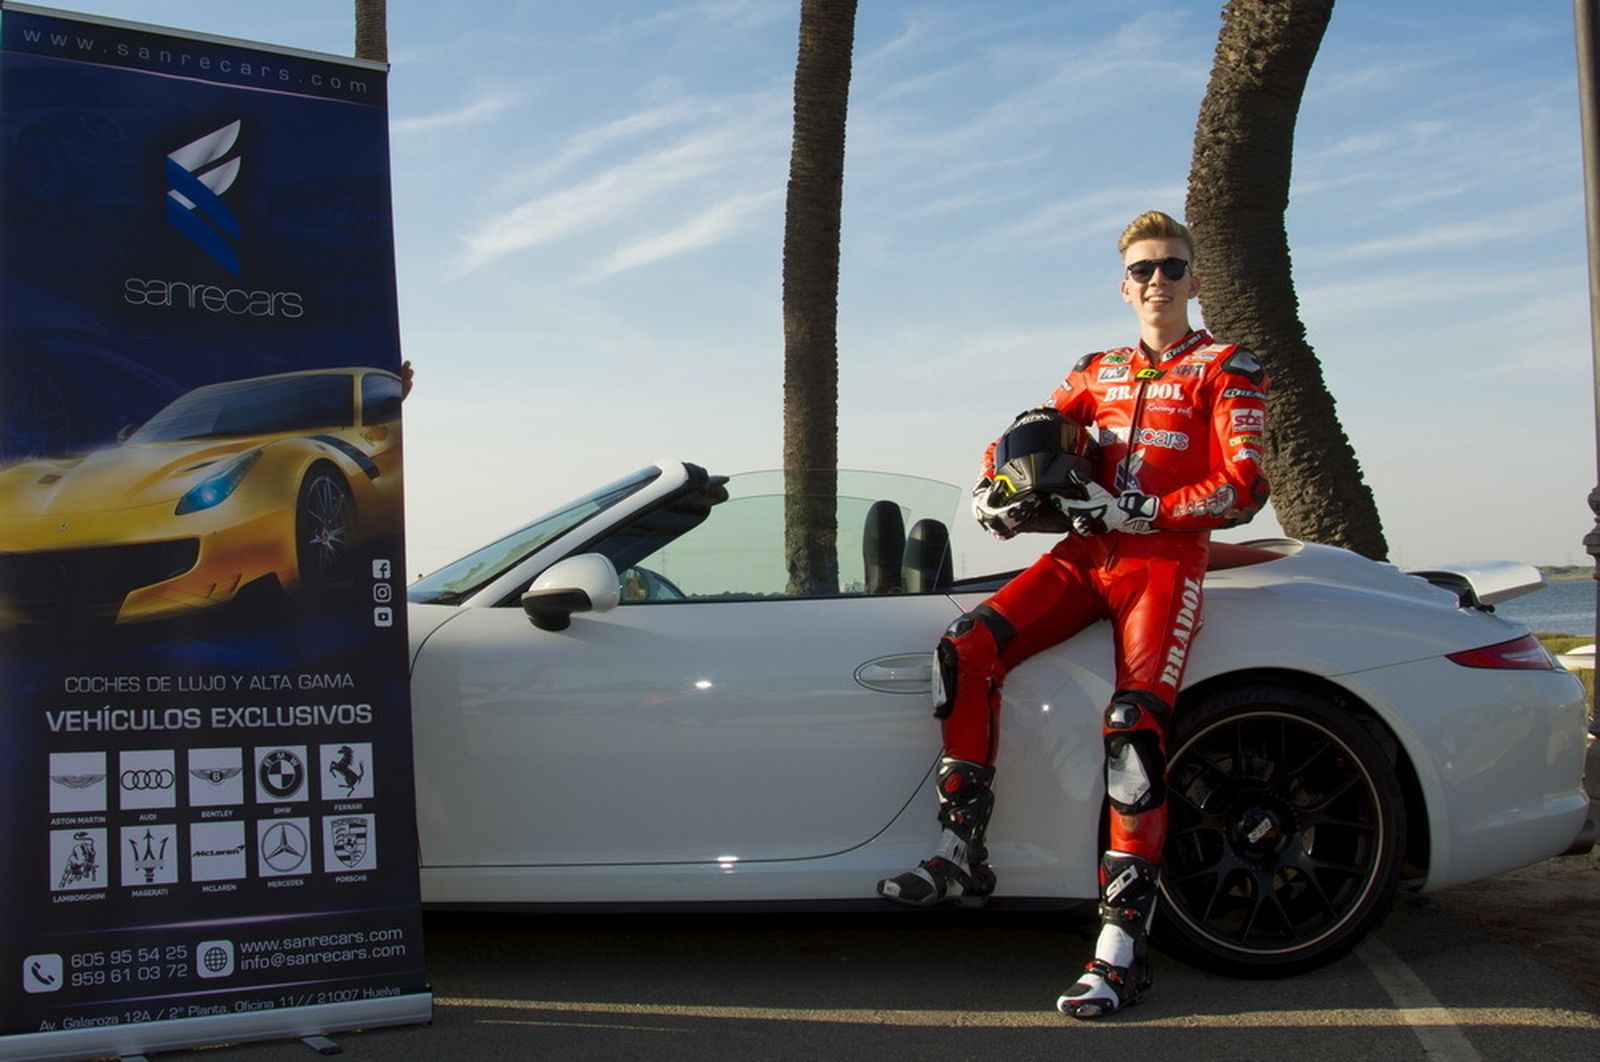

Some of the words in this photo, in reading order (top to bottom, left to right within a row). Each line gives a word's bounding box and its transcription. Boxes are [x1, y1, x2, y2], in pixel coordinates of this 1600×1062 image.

[23, 28, 368, 94] www.sanrecars.com
[123, 277, 304, 318] sanrecars
[1161, 577, 1201, 688] BRADOL
[65, 676, 141, 693] COCHES
[147, 676, 171, 692] DE
[178, 675, 226, 692] LUJO
[230, 675, 244, 691] Y
[249, 674, 293, 691] ALTA
[298, 673, 355, 690] GAMA
[46, 704, 201, 733] VEHÍCULOS
[211, 703, 373, 730] EXCLUSIVOS
[139, 813, 157, 821] AUDI
[201, 810, 233, 819] BENTLEY
[273, 806, 292, 815] BMW
[334, 803, 363, 811] FERRARI
[51, 818, 76, 826] ASTON
[77, 816, 106, 825] MARTIN
[267, 879, 304, 889] MERCEDES
[335, 874, 368, 883] PORSCHE
[53, 893, 106, 903] LAMBORGHINI
[132, 888, 168, 897] MASERATI
[239, 927, 403, 953] www.sanrecars.com
[71, 952, 105, 969] 605
[110, 950, 133, 966] 95
[138, 947, 161, 964] 54
[165, 945, 188, 962] 25
[240, 943, 406, 971] info@sanrecars.com
[71, 970, 105, 987] 959
[110, 968, 132, 984] 61
[137, 966, 161, 982] 03
[167, 964, 188, 979] 72
[125, 1010, 151, 1024] 12A
[318, 989, 359, 1003] 21007
[363, 986, 401, 998] Huelva
